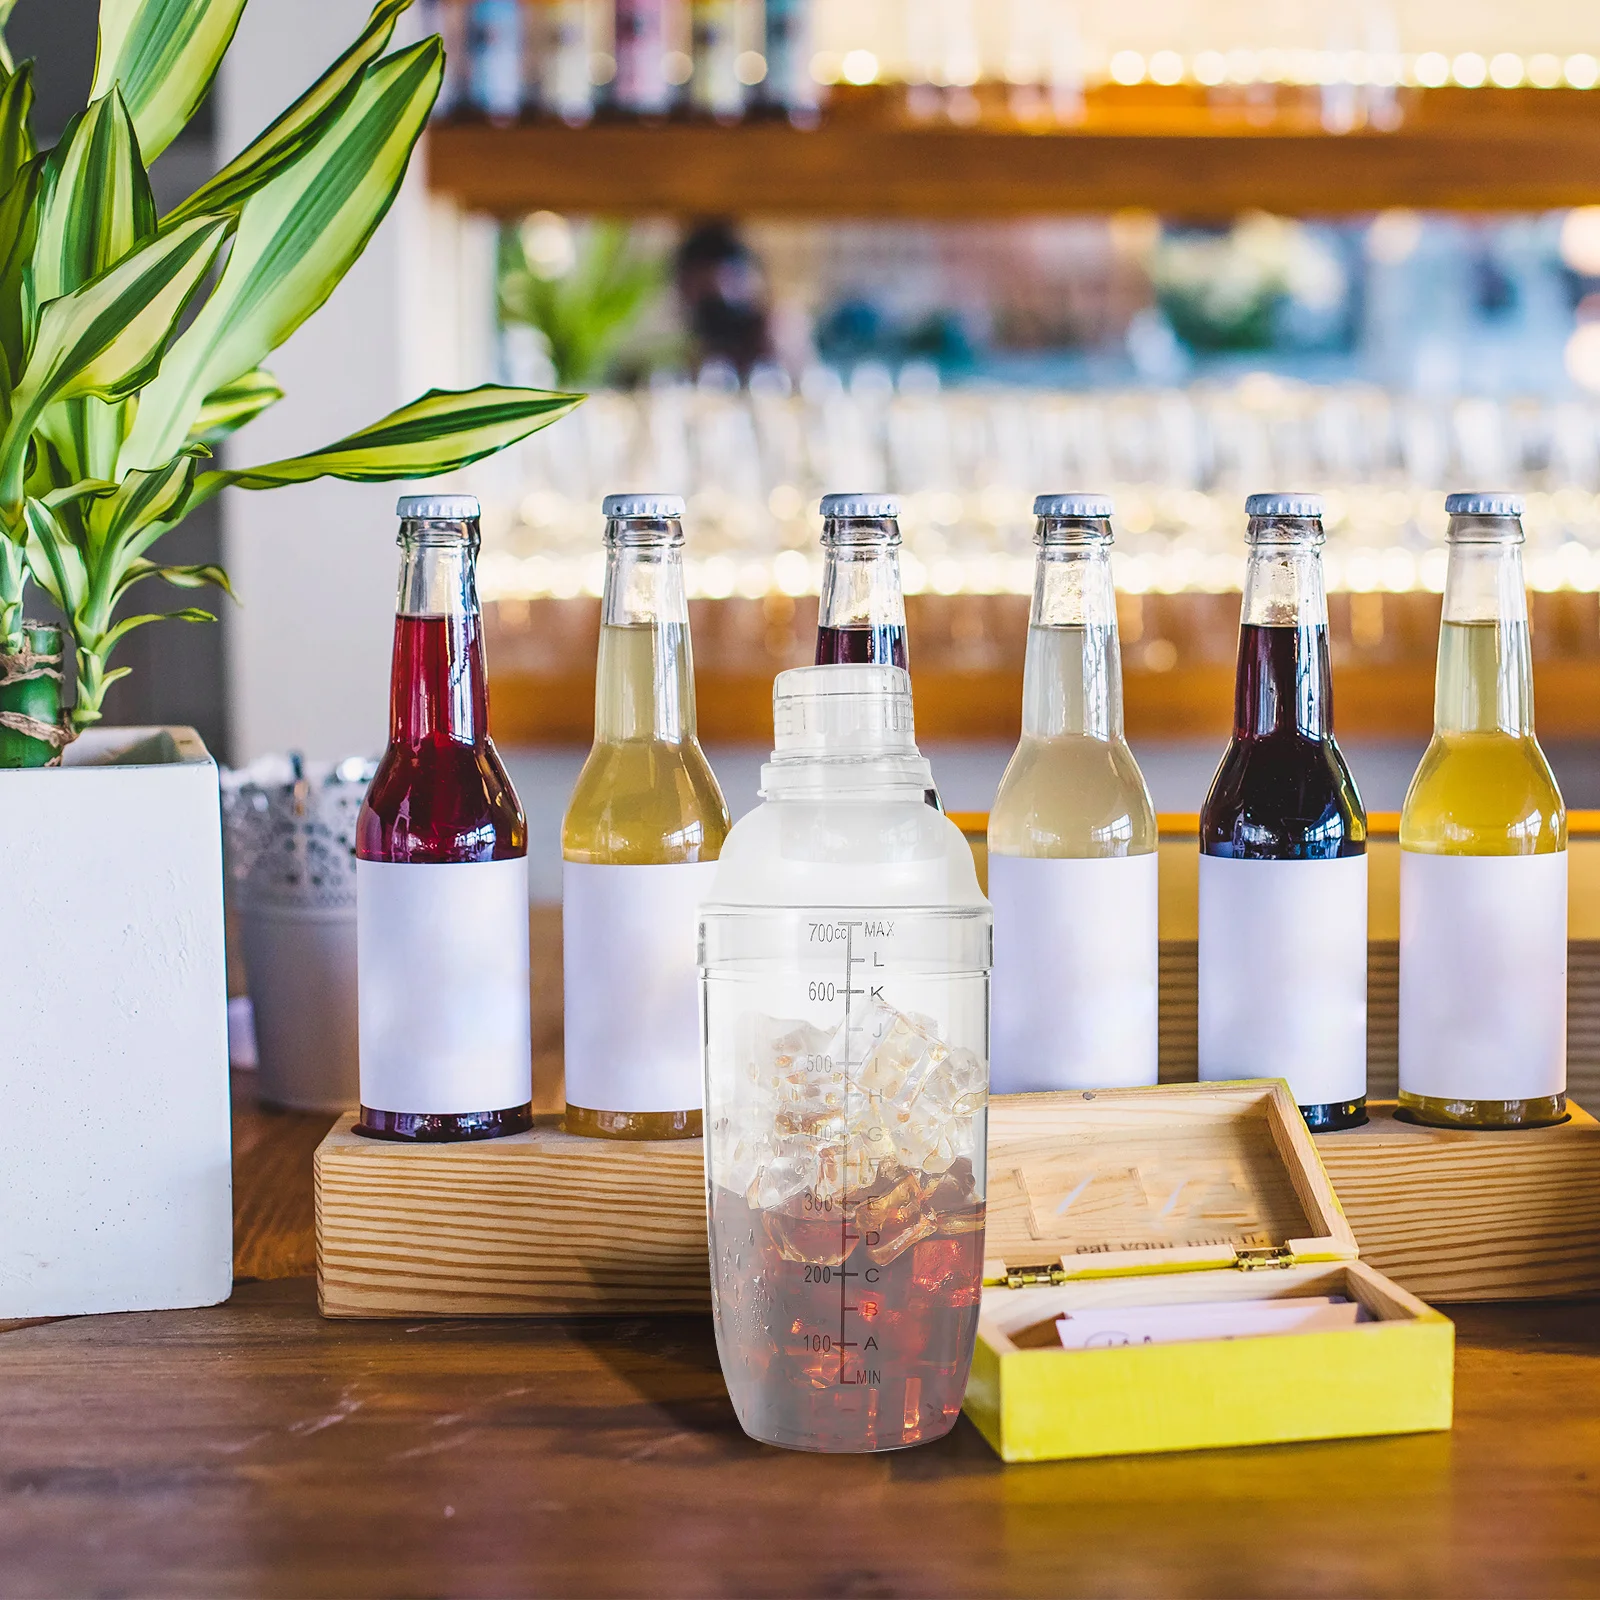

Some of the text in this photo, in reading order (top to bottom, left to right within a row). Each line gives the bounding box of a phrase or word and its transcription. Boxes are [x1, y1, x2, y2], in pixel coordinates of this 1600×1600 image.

[808, 923, 847, 942] 700cc
[864, 921, 895, 937] MAX
[873, 951, 885, 967] L
[808, 981, 835, 1002] 600
[870, 985, 885, 1002] K
[872, 1022, 882, 1038] J
[806, 1054, 832, 1073] 500
[868, 1088, 882, 1104] H
[867, 1126, 883, 1142] G
[804, 1193, 833, 1212] 300
[867, 1195, 881, 1211] E
[865, 1230, 880, 1246] D
[804, 1265, 831, 1284] 200
[864, 1268, 880, 1283] C
[865, 1301, 879, 1317] B
[803, 1334, 831, 1353] 100
[863, 1336, 879, 1351] A
[856, 1370, 881, 1384] MIN
